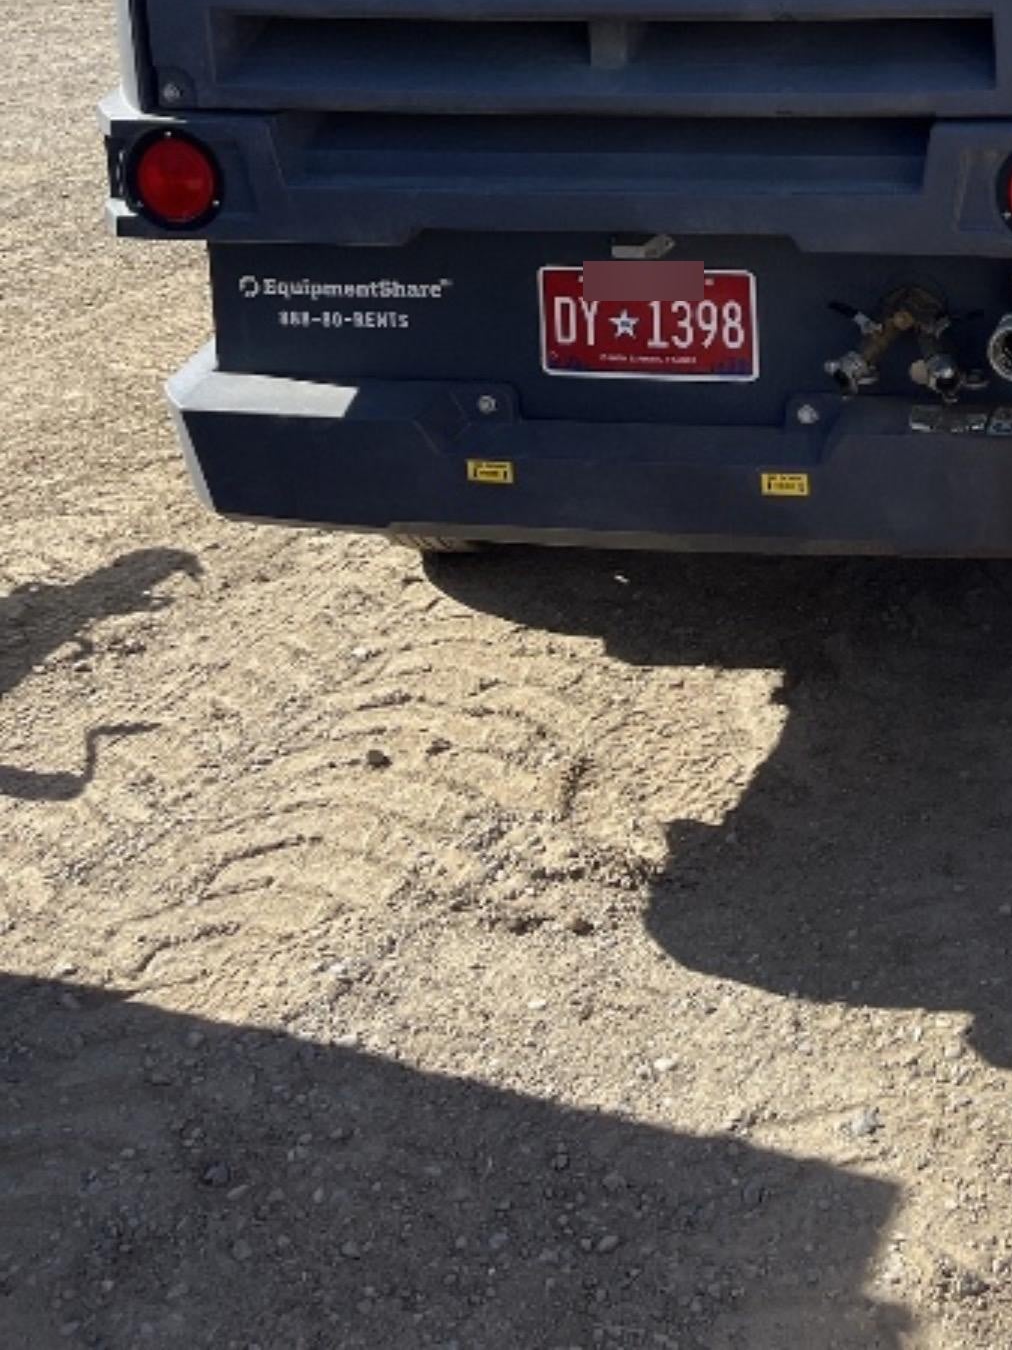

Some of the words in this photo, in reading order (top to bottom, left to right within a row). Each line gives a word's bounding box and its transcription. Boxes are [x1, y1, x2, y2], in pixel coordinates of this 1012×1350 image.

[262, 277, 443, 300] EquipmentShare
[553, 296, 599, 347] DY
[647, 299, 745, 349] 1398
